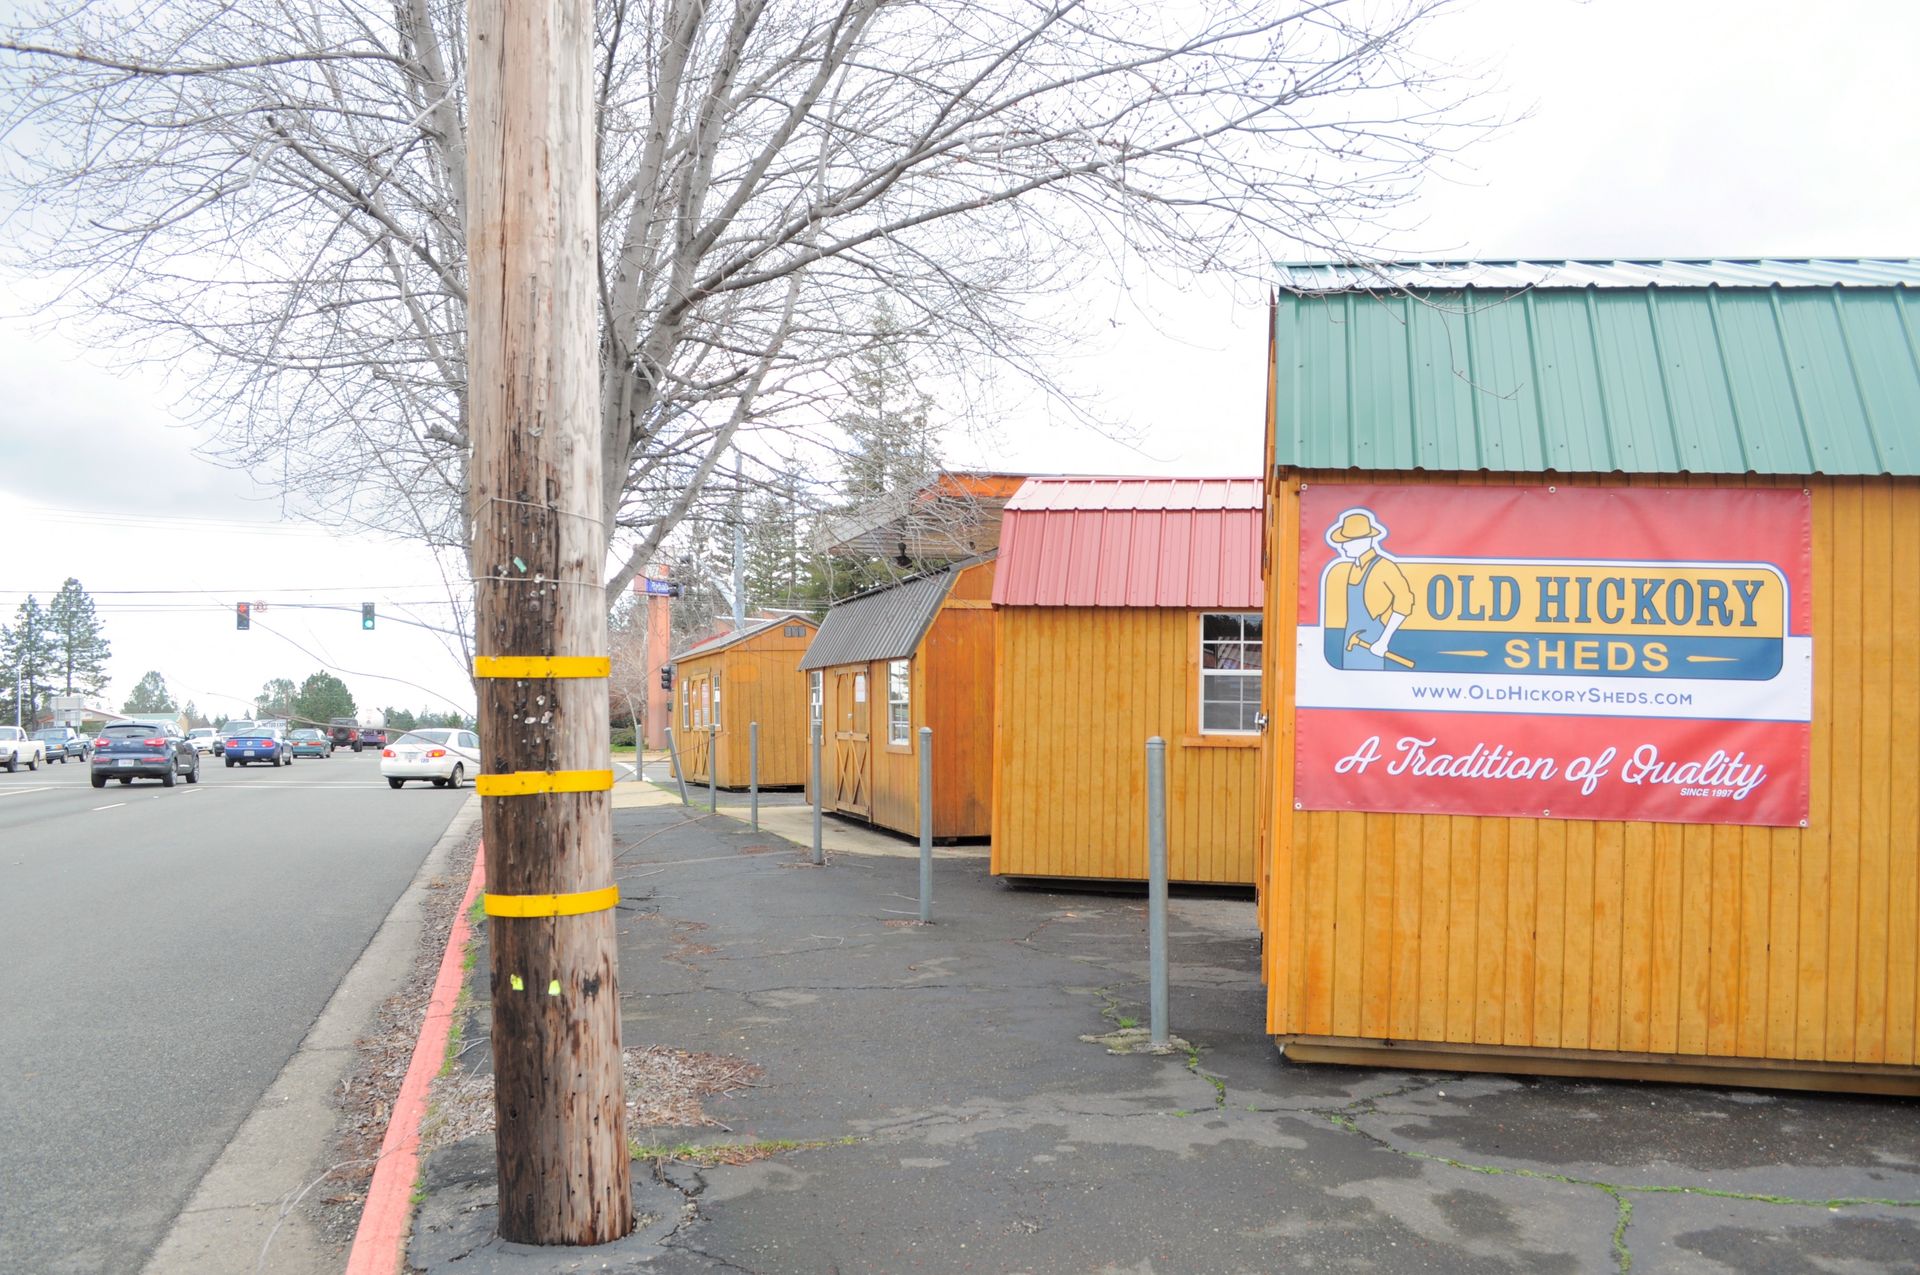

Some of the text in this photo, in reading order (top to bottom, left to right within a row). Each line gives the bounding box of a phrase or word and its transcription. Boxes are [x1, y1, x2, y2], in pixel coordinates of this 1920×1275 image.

[1427, 574, 1765, 627] OLD HICKORY
[1504, 639, 1669, 672] SHEDS
[1334, 735, 1767, 800] A Tradition of Quality
[1680, 787, 1734, 798] SINCE 1997
